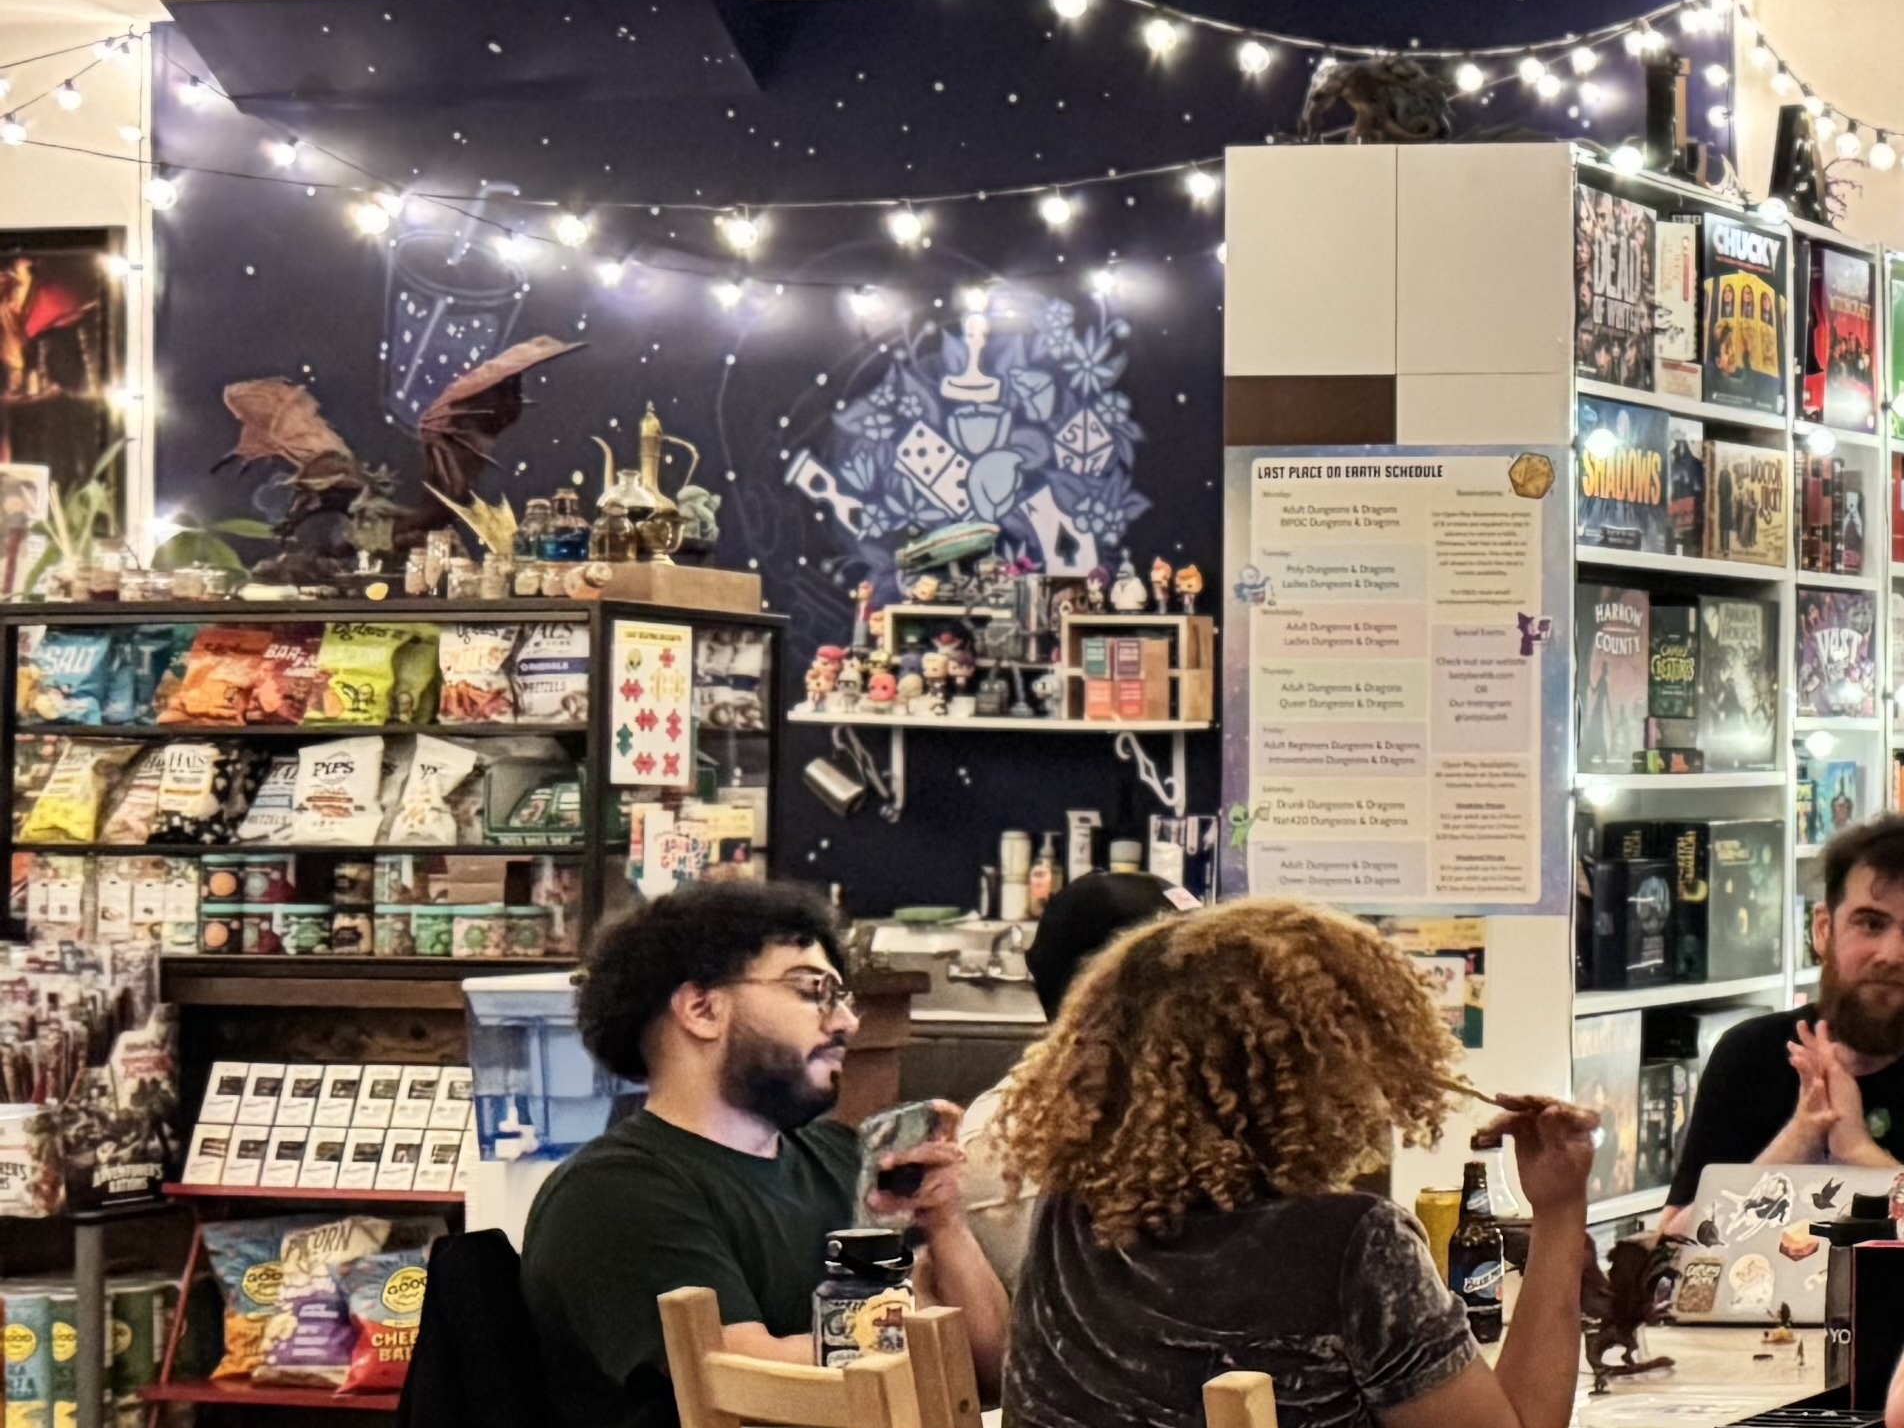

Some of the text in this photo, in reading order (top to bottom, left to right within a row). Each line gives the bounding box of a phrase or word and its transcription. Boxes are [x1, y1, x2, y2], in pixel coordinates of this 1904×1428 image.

[1712, 224, 1781, 270] CHUCKY
[1593, 232, 1642, 304] DEAD
[1258, 466, 1442, 478] LAST PLACE ON EARTH SCHEDULE
[1582, 446, 1662, 506] SHADOWS
[1595, 604, 1643, 628] HARROW
[1595, 632, 1641, 656] COUNTY
[44, 646, 98, 672] SALT
